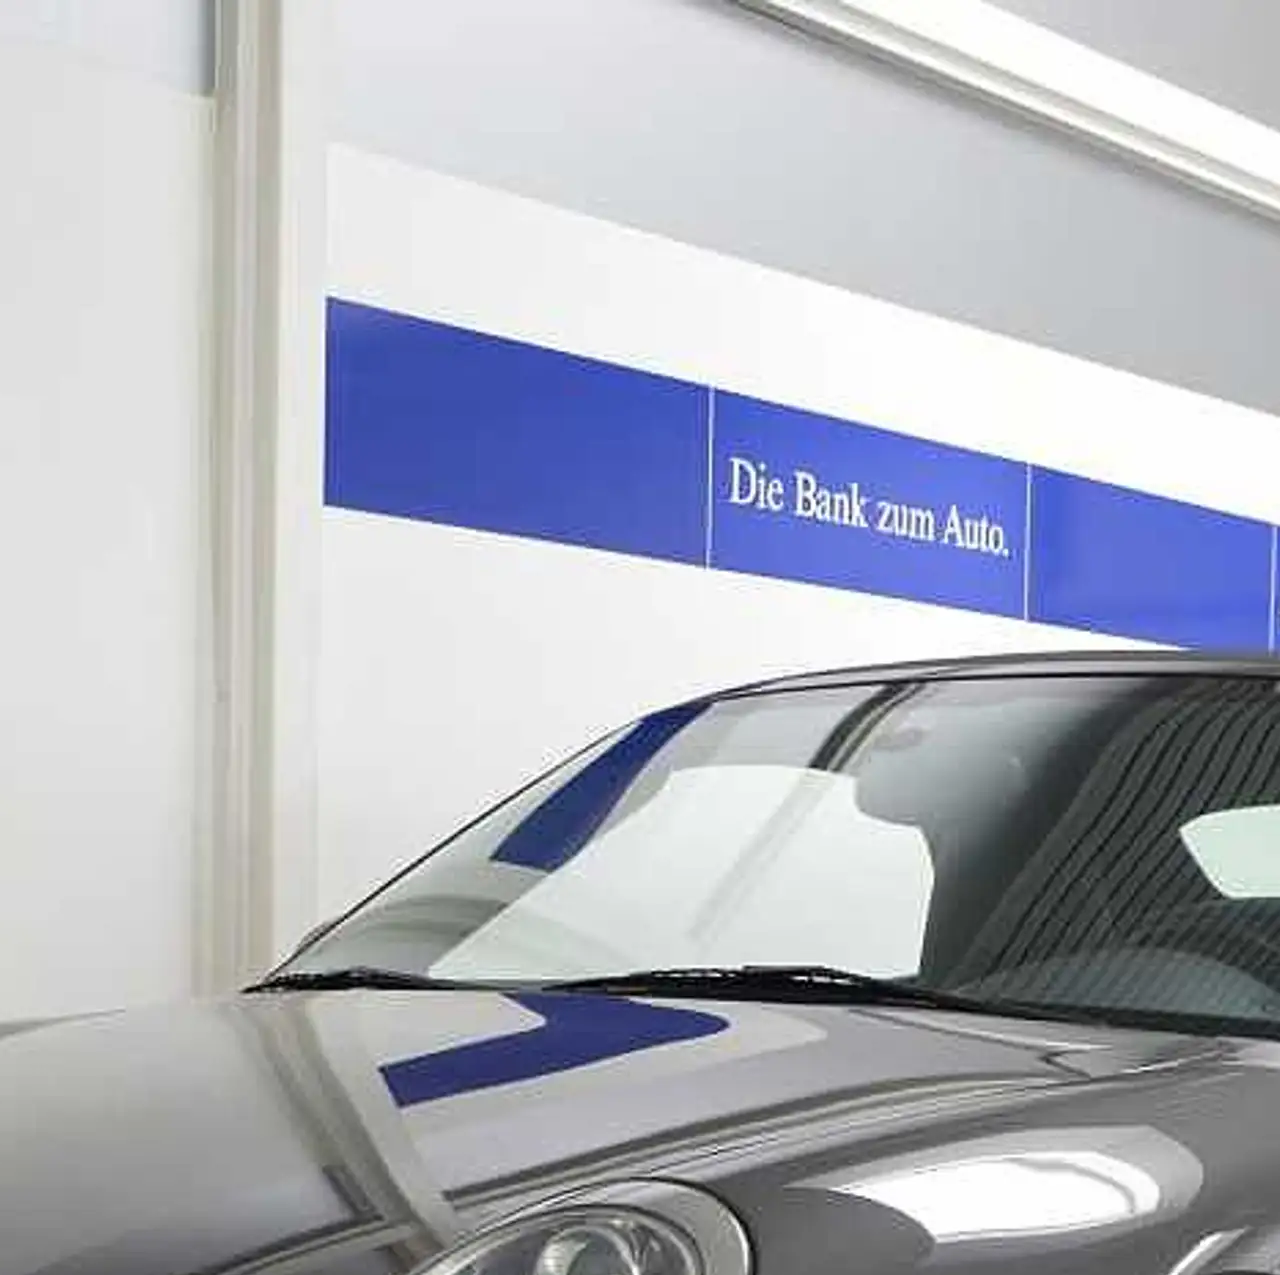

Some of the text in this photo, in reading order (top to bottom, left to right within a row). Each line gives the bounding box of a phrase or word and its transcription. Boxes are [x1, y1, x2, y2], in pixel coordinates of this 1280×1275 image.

[728, 456, 1011, 558] Die Bank zum Auto.
